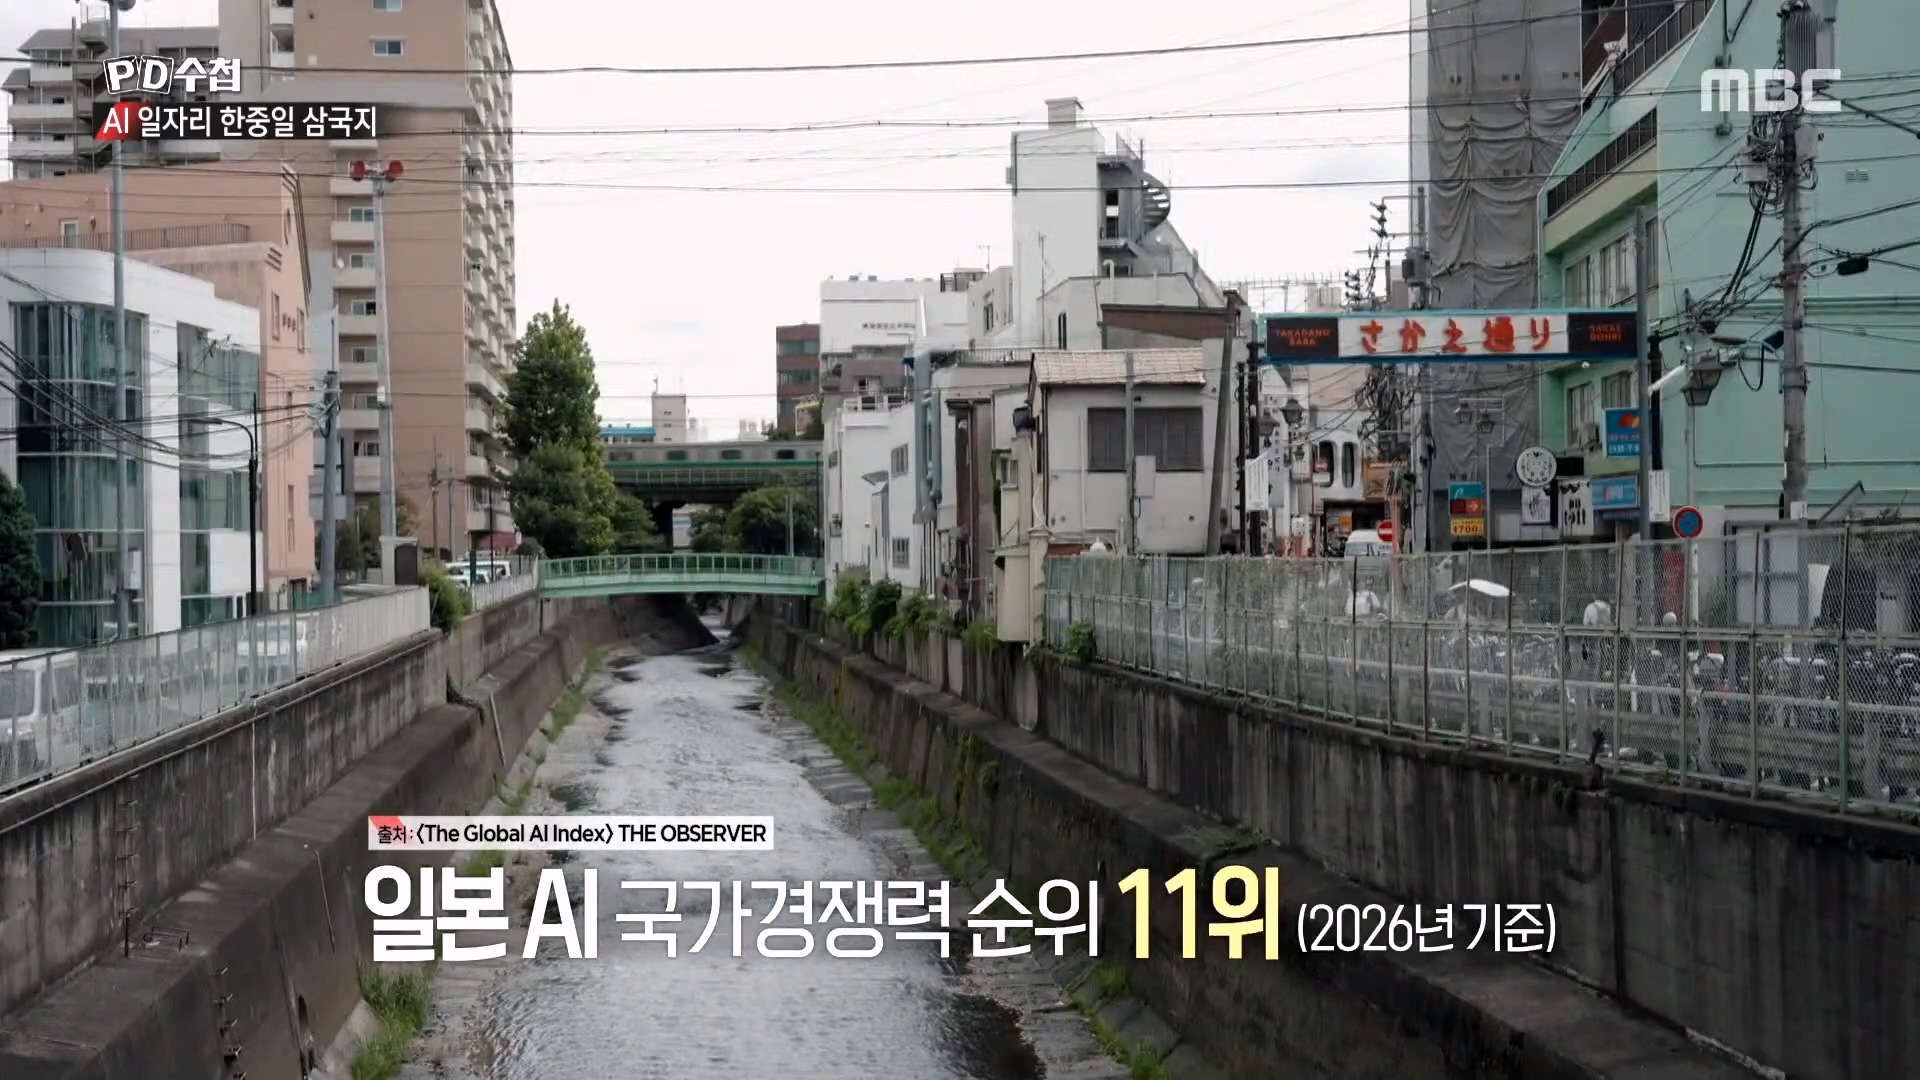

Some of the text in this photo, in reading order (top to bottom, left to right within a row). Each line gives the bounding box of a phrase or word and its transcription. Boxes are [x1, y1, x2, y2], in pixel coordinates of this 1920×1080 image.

[1359, 315, 1550, 353] さかえ通り
